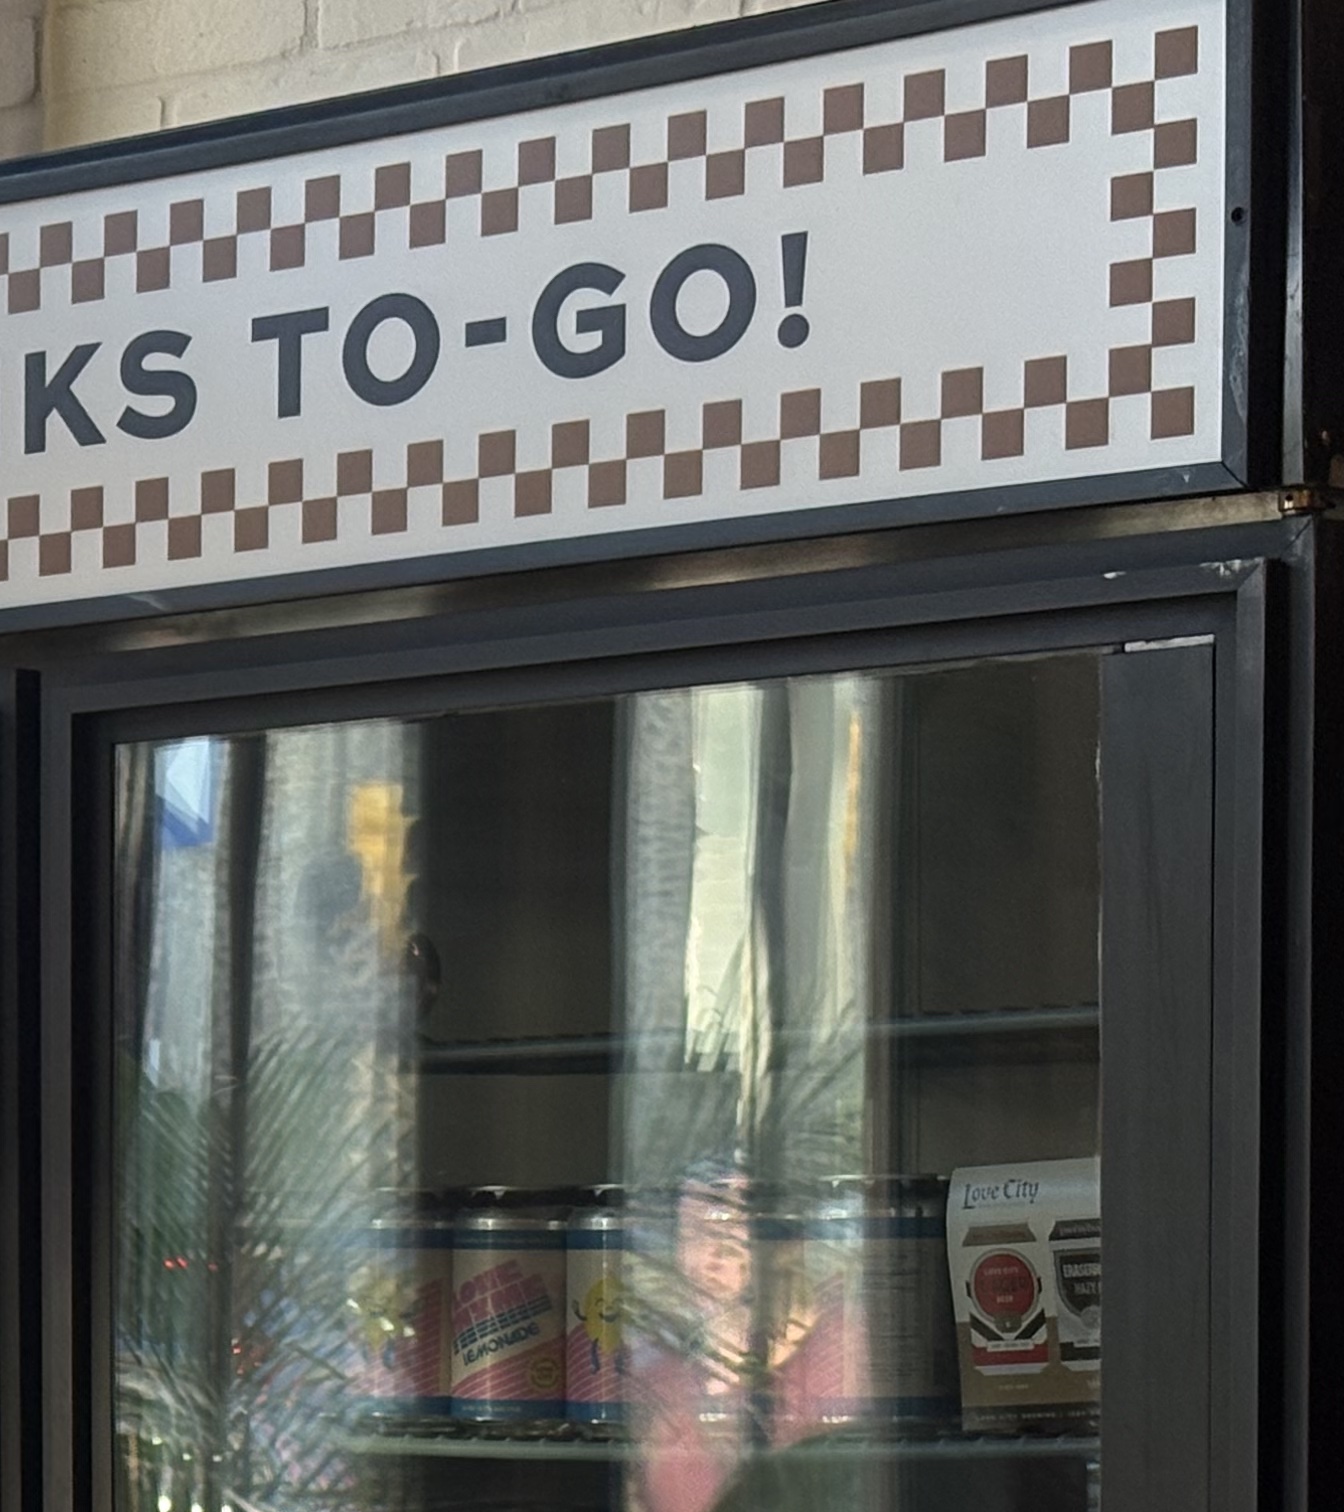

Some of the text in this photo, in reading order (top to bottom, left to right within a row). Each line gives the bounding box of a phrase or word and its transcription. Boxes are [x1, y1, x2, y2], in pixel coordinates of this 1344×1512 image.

[250, 230, 809, 419] TO-GO!
[962, 1178, 1040, 1210] Love City
[462, 1321, 540, 1367] LEMONADE
